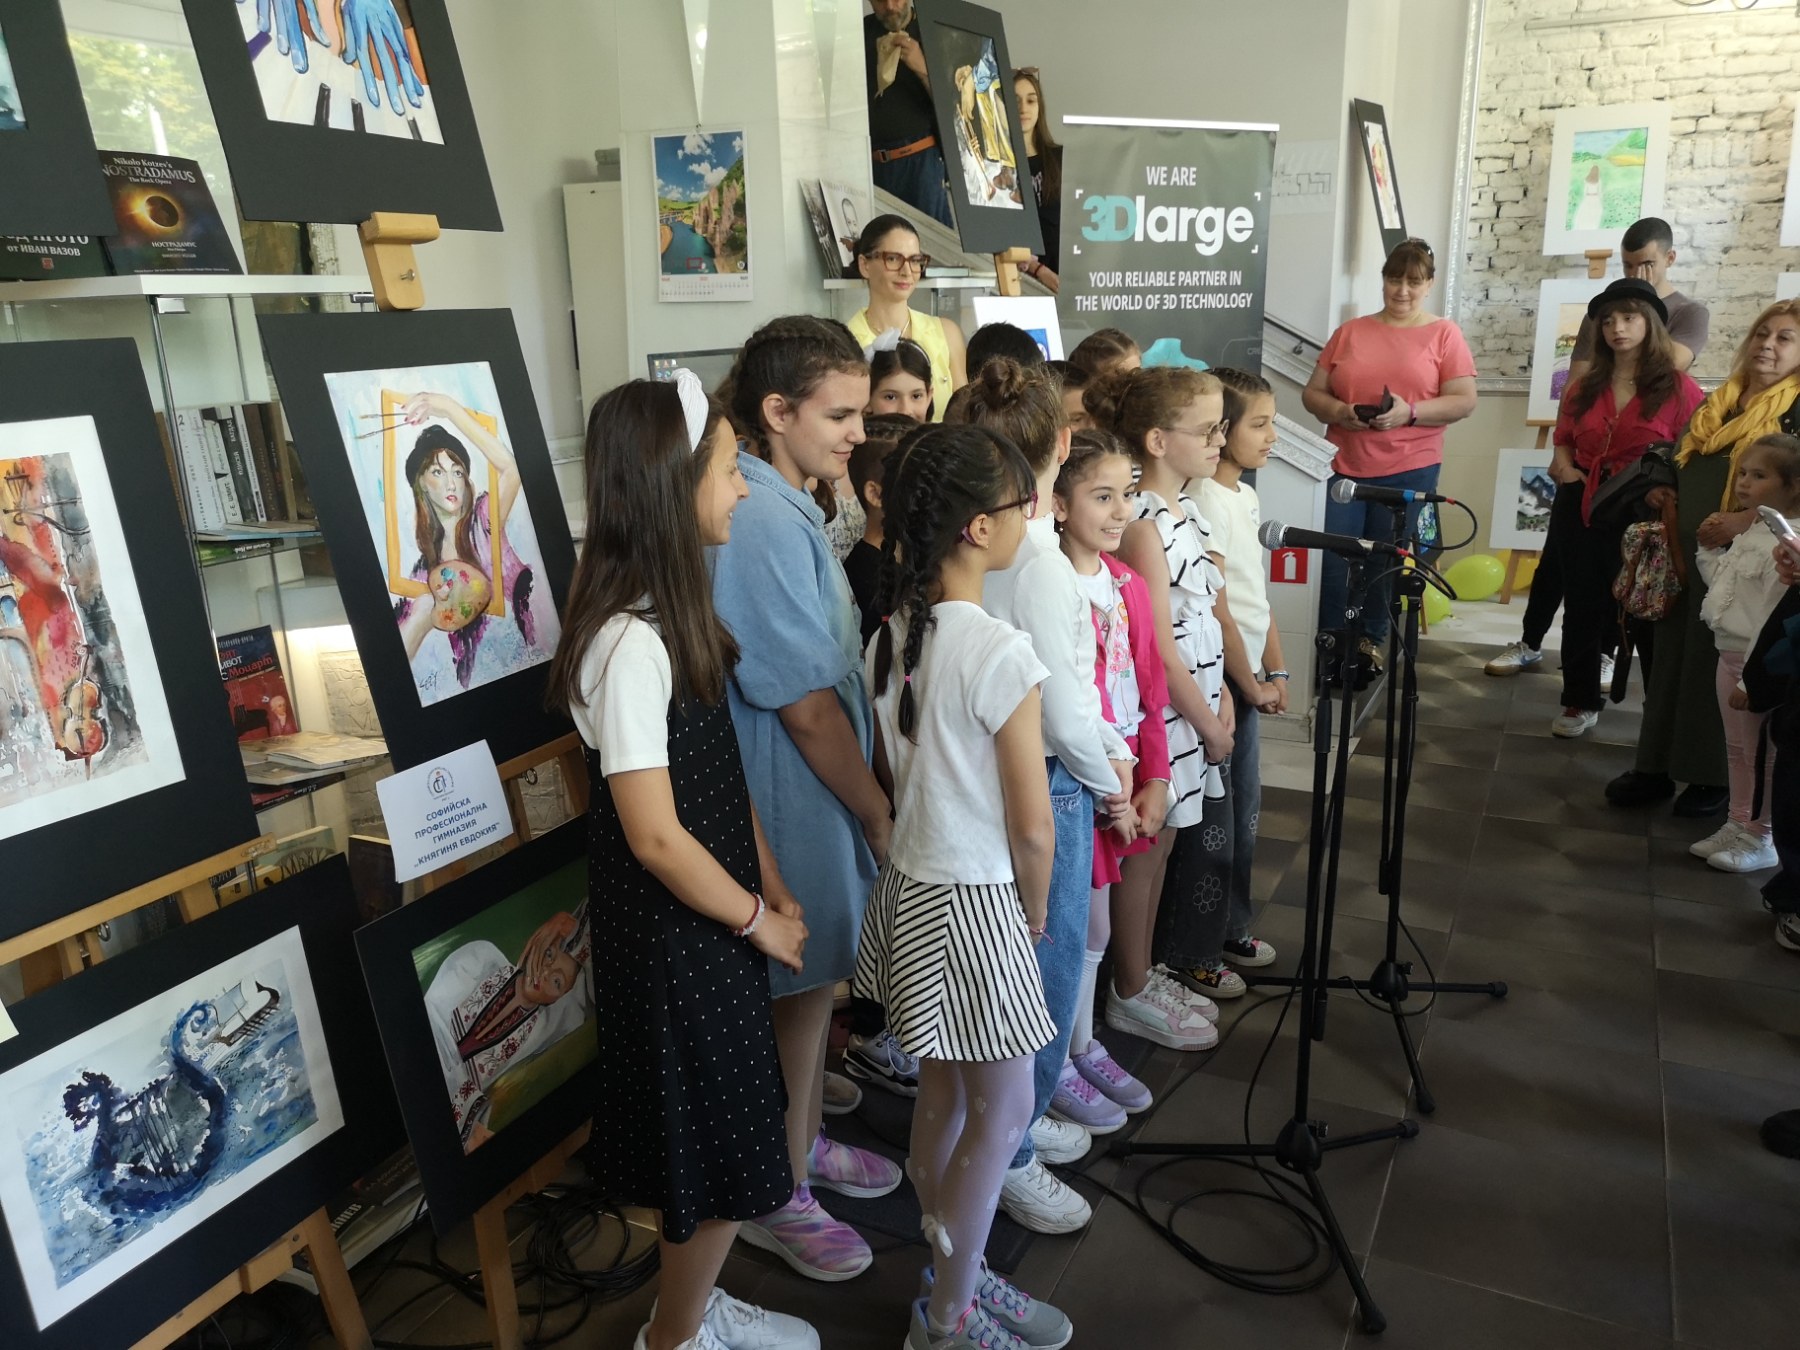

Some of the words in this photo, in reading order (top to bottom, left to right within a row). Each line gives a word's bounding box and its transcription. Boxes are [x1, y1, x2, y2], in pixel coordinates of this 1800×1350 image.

[1146, 166, 1167, 186] WE
[1170, 167, 1197, 186] ARE
[1081, 195, 1254, 256] 3Dlarge
[20, 244, 49, 255] ИВАН
[49, 246, 81, 257] ВАЗОВ
[1089, 271, 1122, 288] YOUR
[1125, 271, 1175, 287] RELIABLE
[1178, 270, 1227, 287] PARTNER
[1229, 270, 1242, 286] IN
[1075, 295, 1098, 312] THE
[1100, 294, 1142, 311] WORLD
[1145, 294, 1161, 310] OF
[1162, 294, 1177, 310] 3D
[1179, 292, 1253, 309] TECHNOLOGY
[426, 797, 471, 821] СОФИЙСКА
[414, 802, 488, 839] ПРОФЕСИОНАЛНА
[432, 818, 478, 844] ГИМНАЗИЯ
